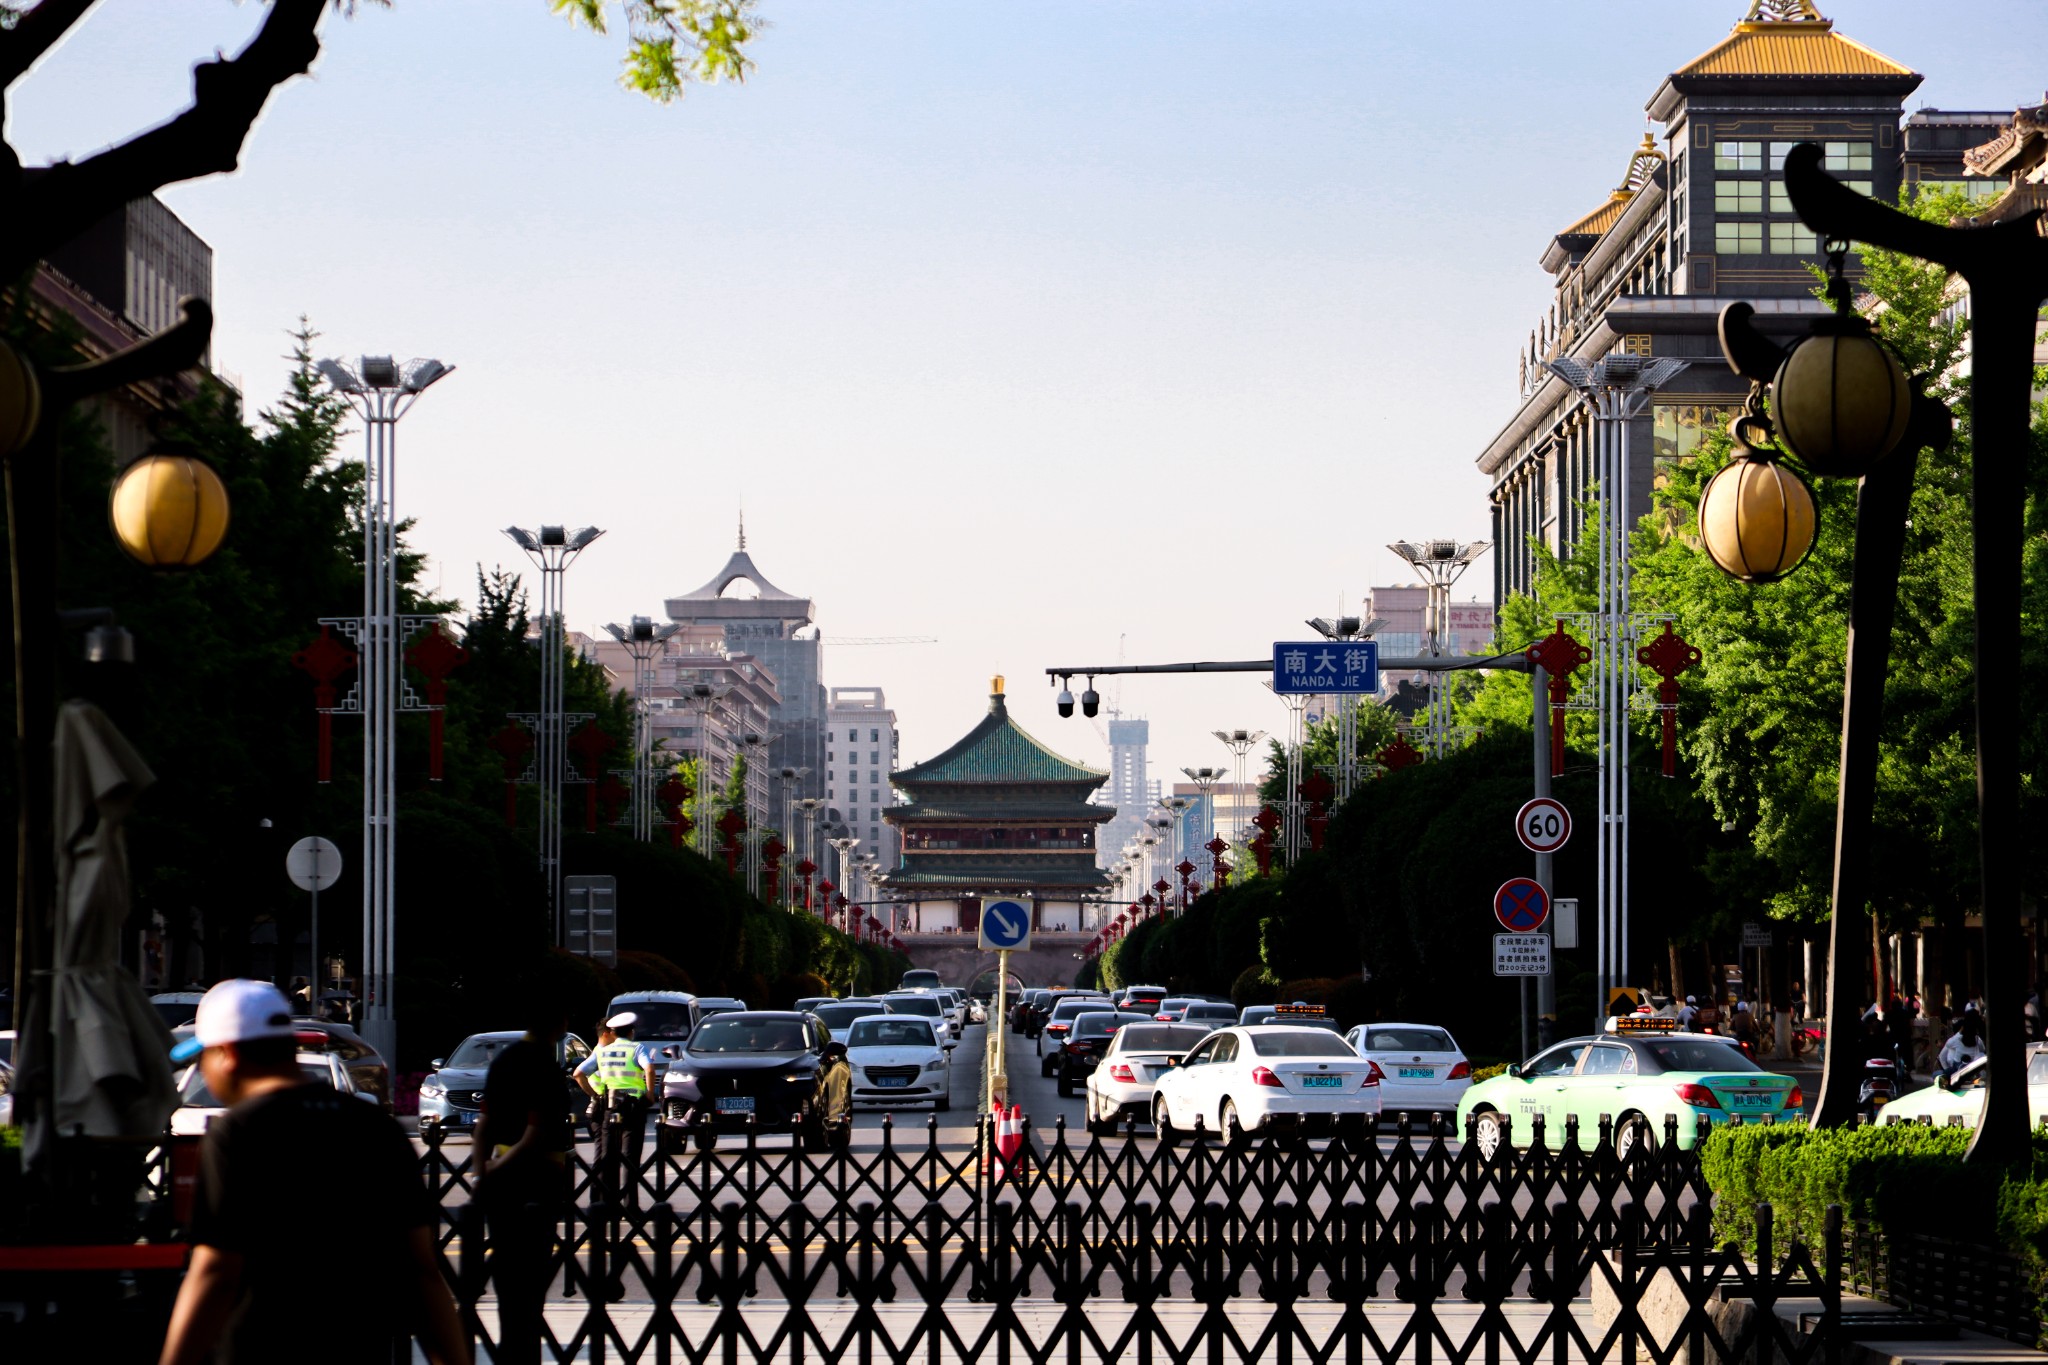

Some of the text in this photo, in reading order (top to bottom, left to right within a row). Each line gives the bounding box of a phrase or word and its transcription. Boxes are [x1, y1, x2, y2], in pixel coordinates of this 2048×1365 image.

[1283, 649, 1369, 674] 南大街
[1291, 675, 1360, 688] NANDA JIE
[1528, 814, 1560, 838] 60
